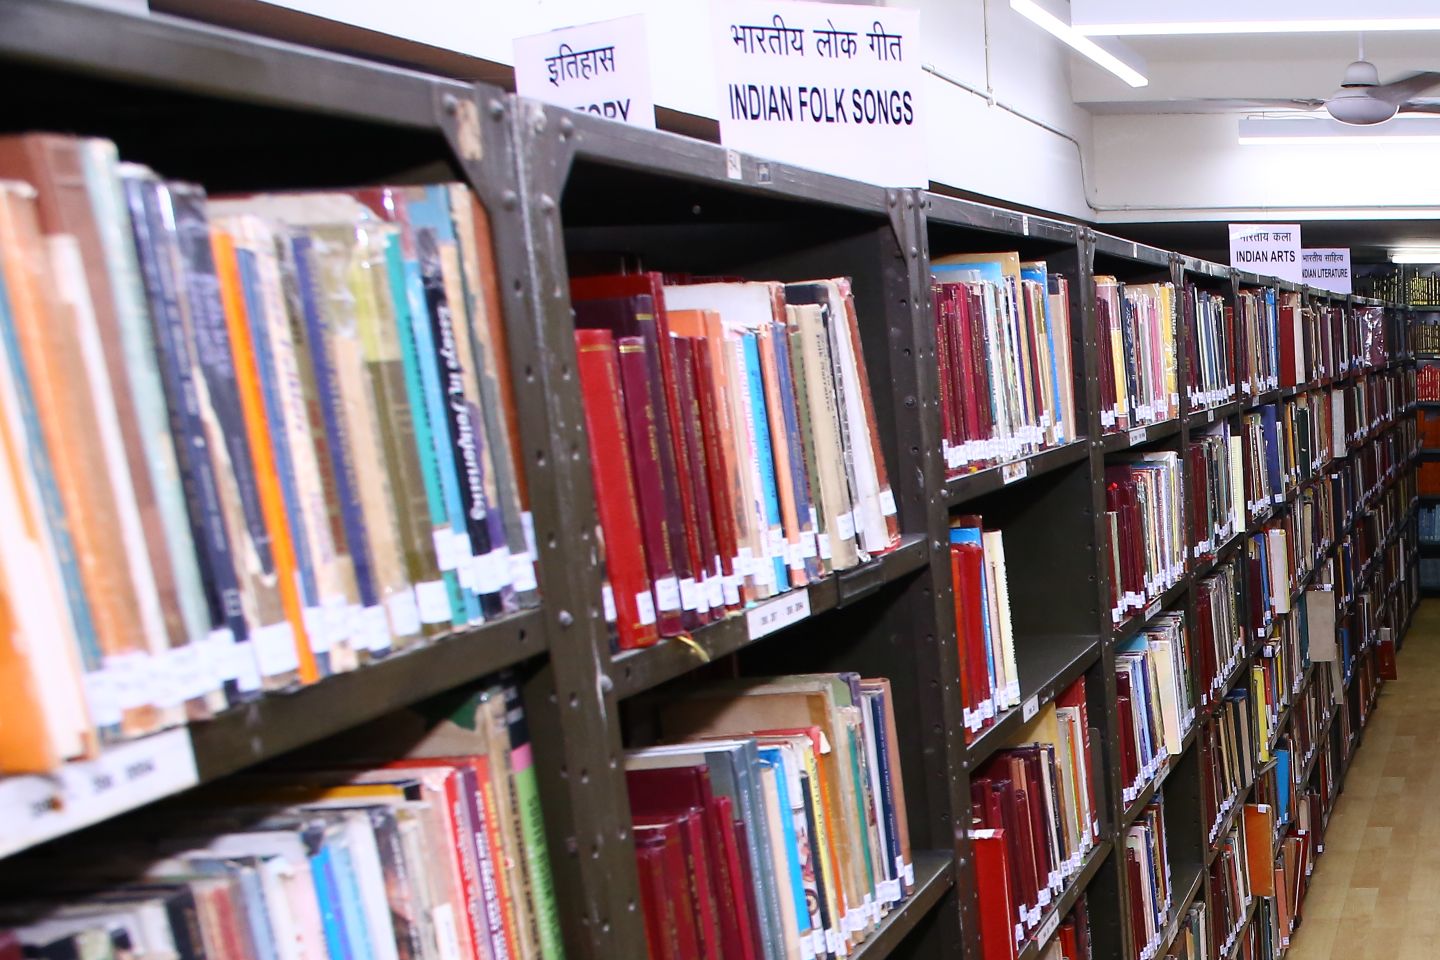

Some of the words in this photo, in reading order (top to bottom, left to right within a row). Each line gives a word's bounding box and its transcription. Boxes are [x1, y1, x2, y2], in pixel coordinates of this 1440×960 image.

[730, 14, 804, 57] भारतीय
[814, 18, 857, 60] लोक
[867, 21, 903, 62] गीत
[544, 43, 615, 87] इतिहास
[728, 83, 796, 123] INDIAN
[799, 86, 846, 124] FOLK
[852, 89, 914, 126] SONGS
[1272, 232, 1292, 242] कला
[1236, 250, 1268, 263] INDIAN
[1270, 250, 1296, 263] ARTS
[1302, 268, 1317, 278] NDIAN
[1317, 268, 1348, 278] LITERATURE
